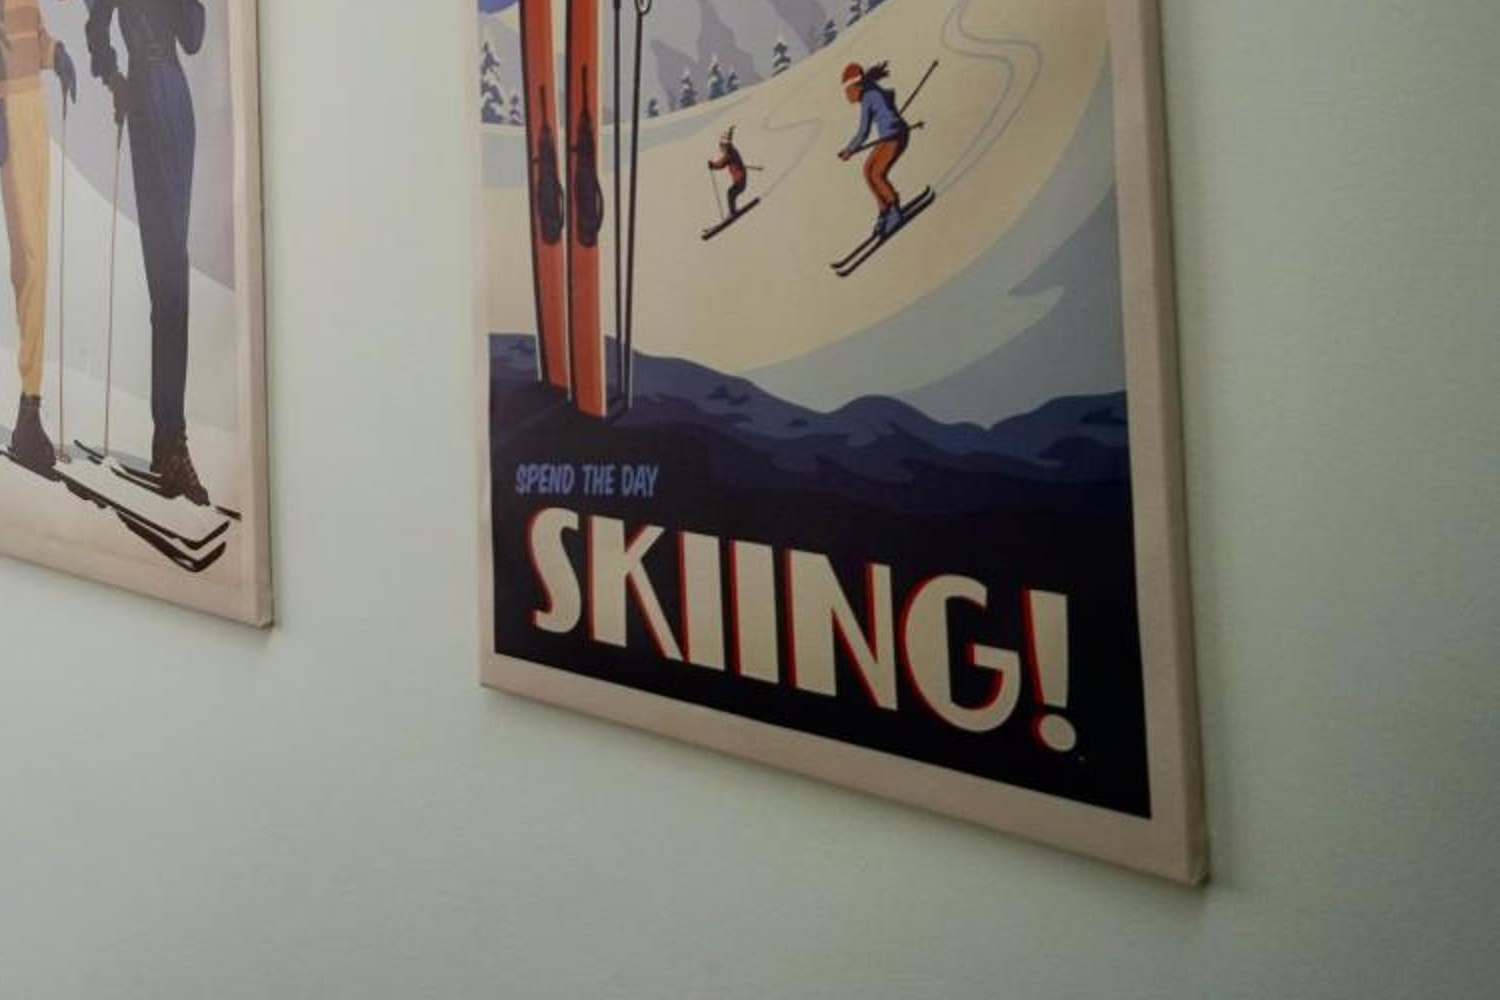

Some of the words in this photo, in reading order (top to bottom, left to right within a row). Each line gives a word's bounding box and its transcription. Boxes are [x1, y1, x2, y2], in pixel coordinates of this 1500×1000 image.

[515, 464, 575, 496] SPEND
[582, 464, 614, 496] THE
[621, 465, 659, 498] DAY
[525, 507, 1077, 752] SKIING!
